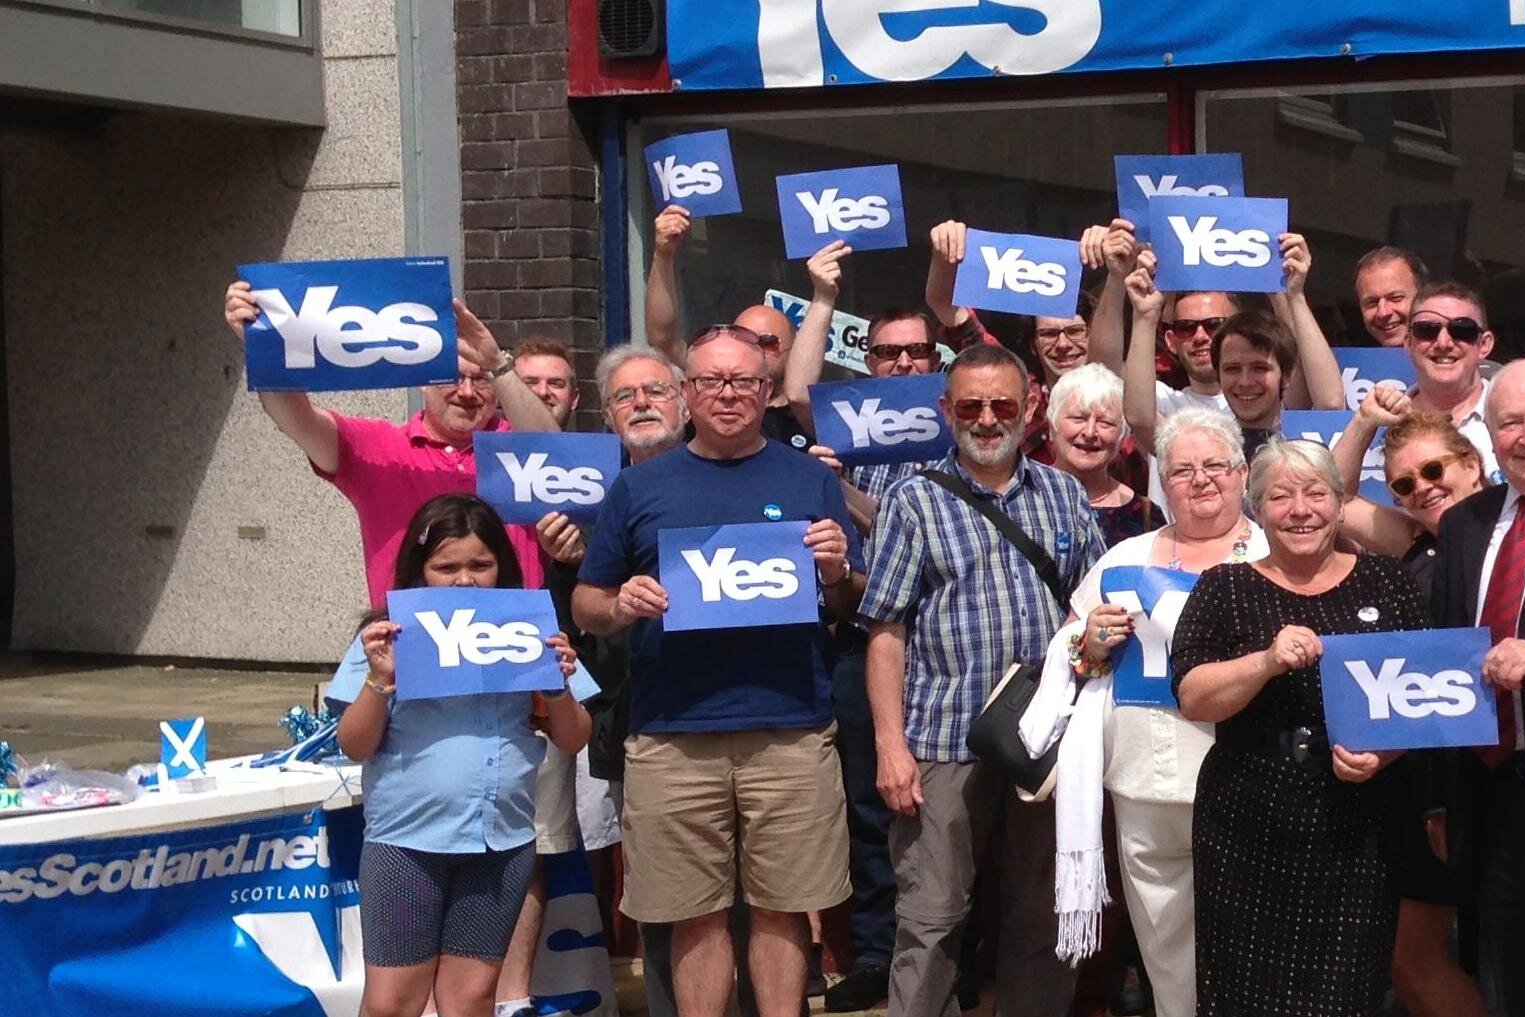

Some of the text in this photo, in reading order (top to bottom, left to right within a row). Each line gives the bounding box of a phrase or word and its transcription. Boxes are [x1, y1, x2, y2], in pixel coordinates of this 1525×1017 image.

[653, 155, 723, 201] Yes
[795, 188, 890, 234] Yes
[1167, 215, 1271, 268] Yes
[979, 245, 1067, 297] Yes
[250, 285, 443, 369] Yes
[831, 398, 940, 448] Yes
[496, 453, 605, 505] Yes
[680, 547, 799, 602] Yes
[414, 609, 544, 667] Yes
[1344, 658, 1477, 720] Yes
